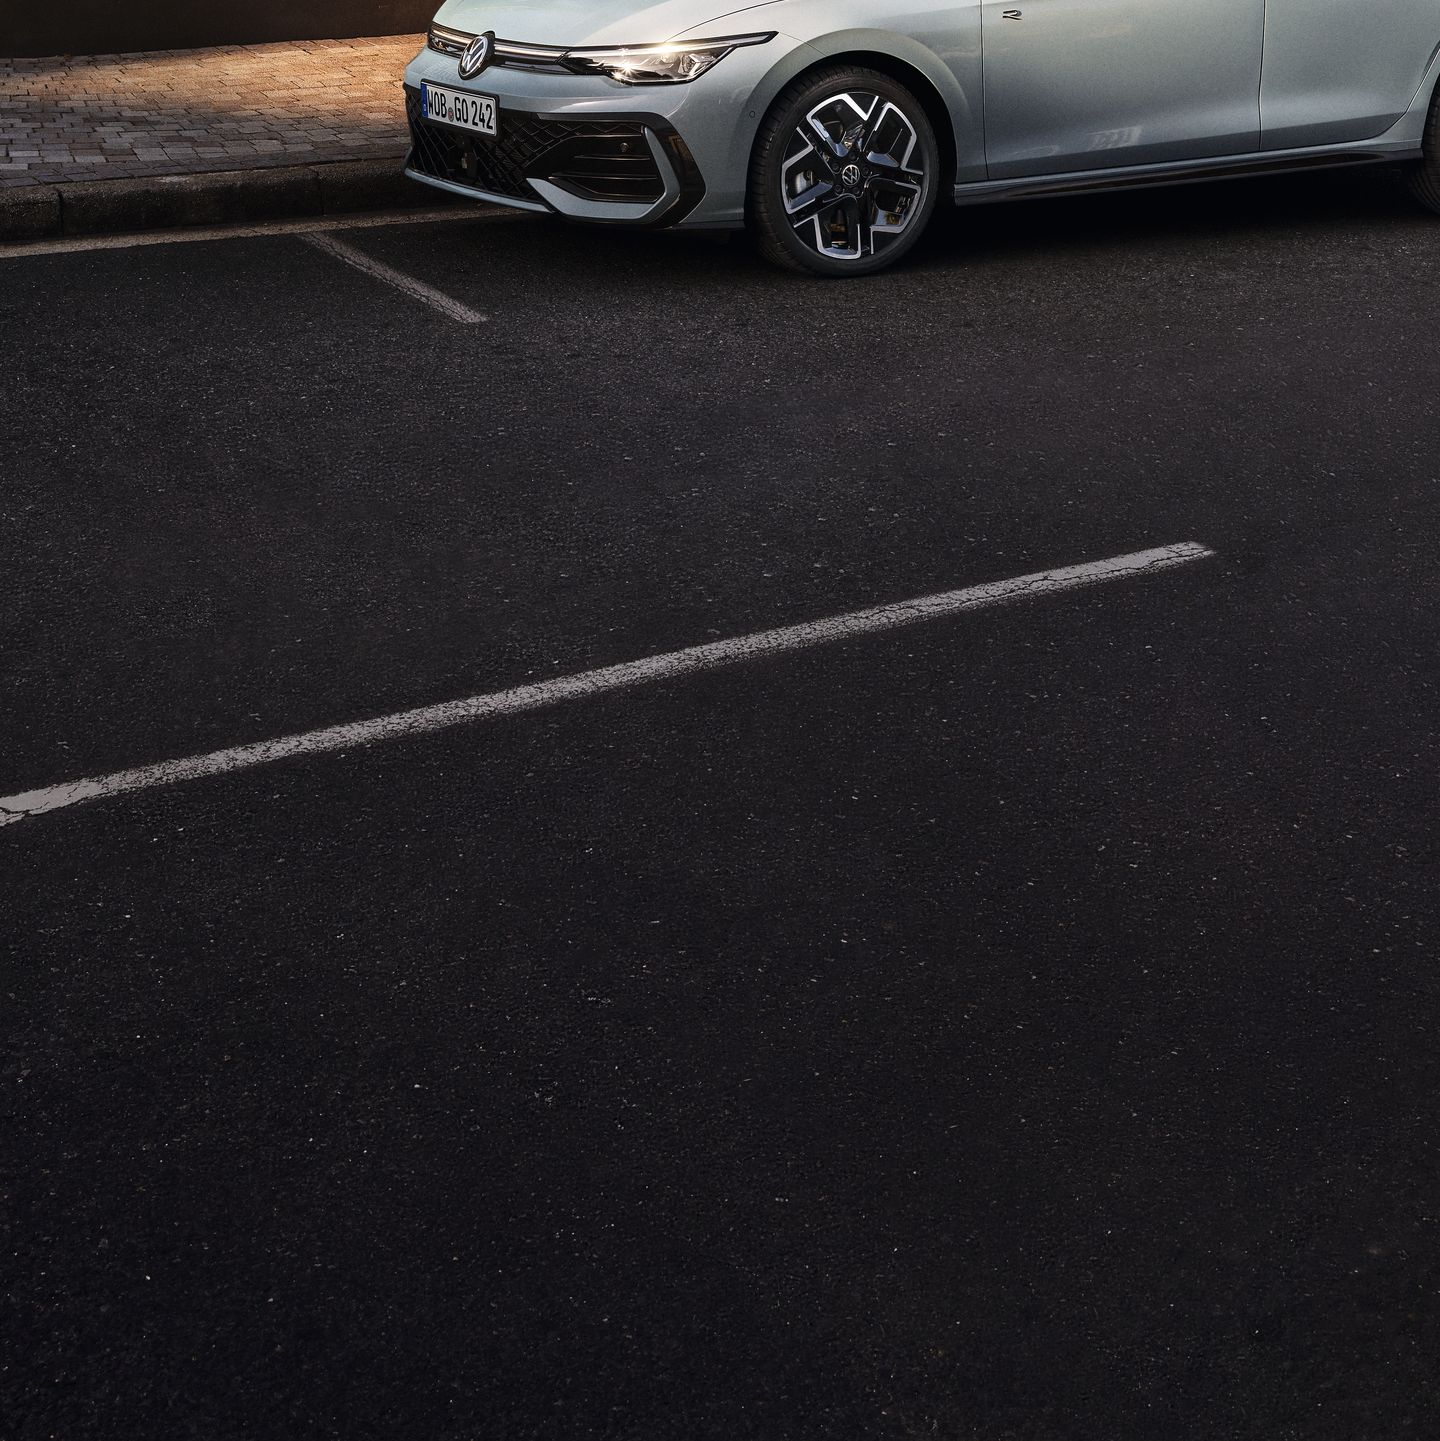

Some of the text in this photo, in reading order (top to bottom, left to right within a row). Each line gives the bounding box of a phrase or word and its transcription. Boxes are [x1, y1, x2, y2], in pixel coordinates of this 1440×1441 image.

[428, 89, 494, 130] WOB GO 242
